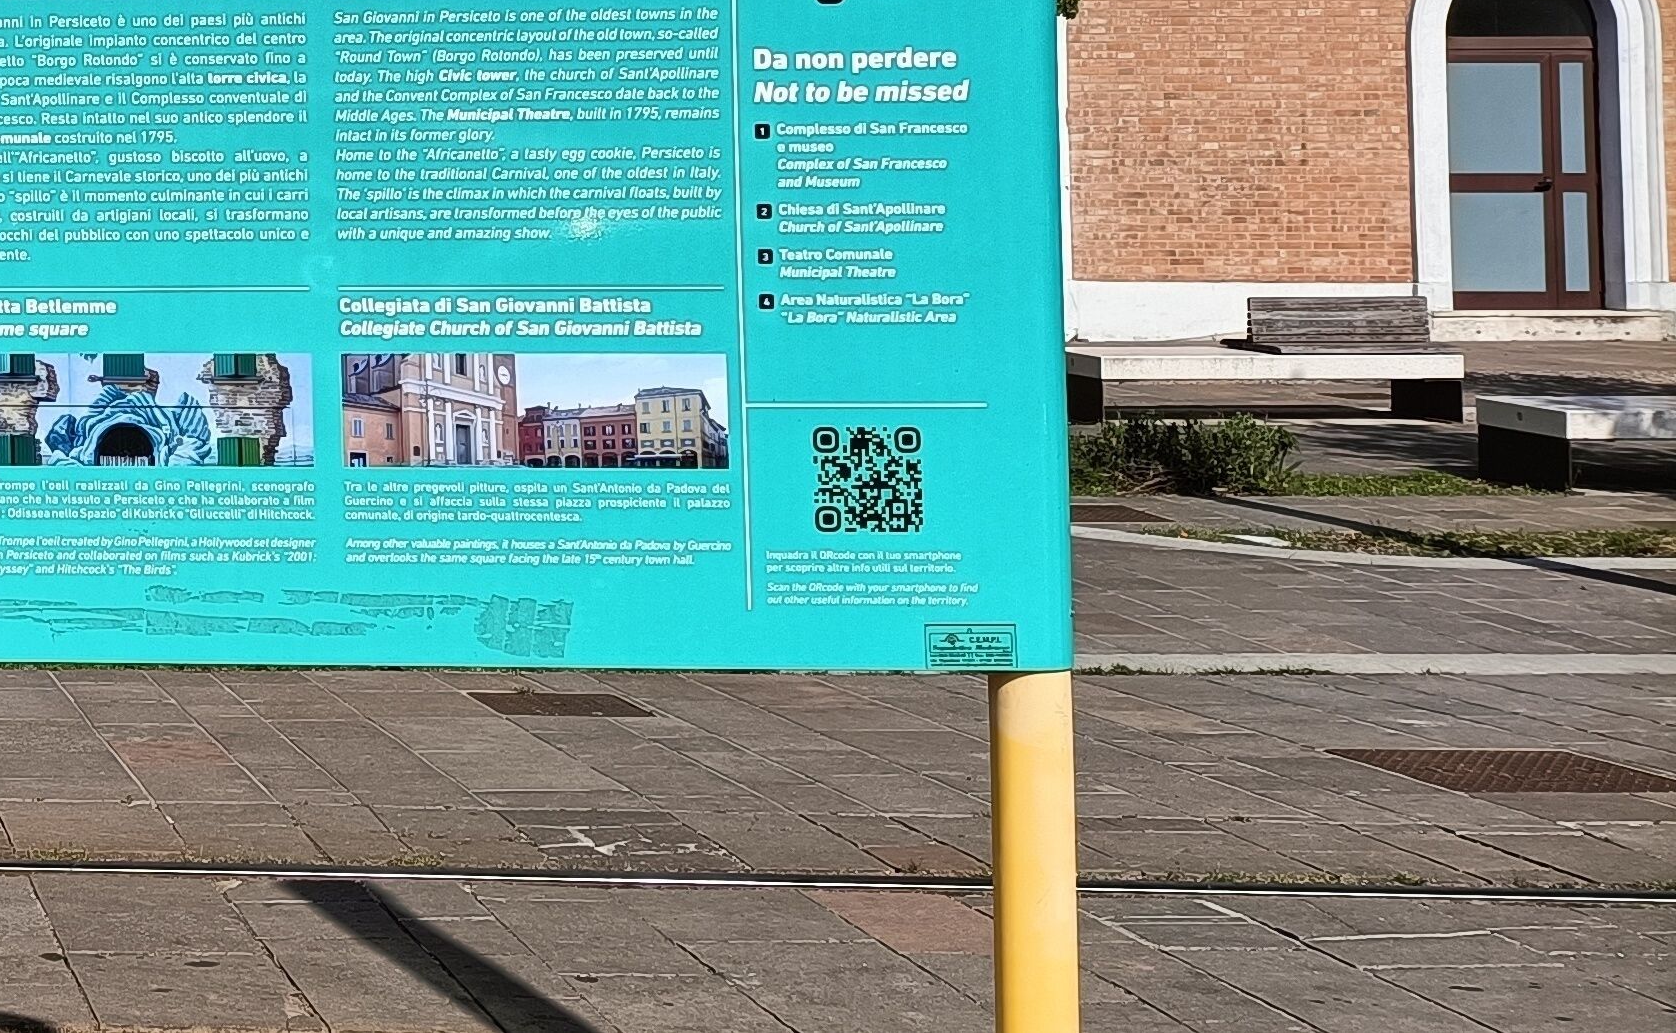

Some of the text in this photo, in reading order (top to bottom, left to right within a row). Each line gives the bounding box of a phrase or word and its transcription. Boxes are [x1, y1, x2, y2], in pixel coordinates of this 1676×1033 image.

[89, 34, 147, 49] impianto
[153, 33, 229, 46] concentrico
[236, 32, 258, 45] del
[263, 33, 306, 44] centro
[754, 47, 957, 73] Da non perdere
[754, 79, 969, 102] Not to be missed
[777, 123, 851, 137] Complesso
[854, 123, 867, 134] di
[870, 123, 896, 134] San
[899, 122, 967, 133] Francesco
[55, 131, 112, 143] costruito
[117, 131, 136, 143] nel
[777, 143, 834, 152] e museo
[778, 157, 947, 172] Complex of San Francesco
[778, 176, 860, 187] and Museum
[778, 203, 824, 215] Chiesa
[826, 203, 840, 215] di
[338, 227, 365, 239] with
[368, 230, 377, 239] a
[380, 227, 424, 241] unique
[427, 227, 452, 239] and
[455, 226, 511, 241] amazing
[779, 221, 825, 233] Church
[828, 221, 842, 232] of
[779, 249, 823, 260] Teatro
[825, 248, 893, 260] Comunale
[780, 266, 896, 280] Municipal Theatre
[780, 294, 814, 305] Area
[816, 293, 902, 305] Naturalistica
[26, 299, 116, 313] Betlemme
[340, 297, 651, 316] Collegiata di San Giovanni Battista
[846, 311, 922, 323] Naturalistic
[924, 311, 956, 322] Area
[29, 325, 88, 339] square
[341, 320, 701, 339] Collegiate Church of San Giovanni Battista
[403, 510, 414, 520] di
[416, 510, 455, 522] origine
[766, 551, 809, 561] Inquadra
[811, 551, 818, 559] il
[819, 550, 856, 560] QRcode
[877, 551, 884, 560] il
[885, 552, 901, 560] tuo
[903, 551, 961, 561] smartphone
[35, 564, 55, 574] and
